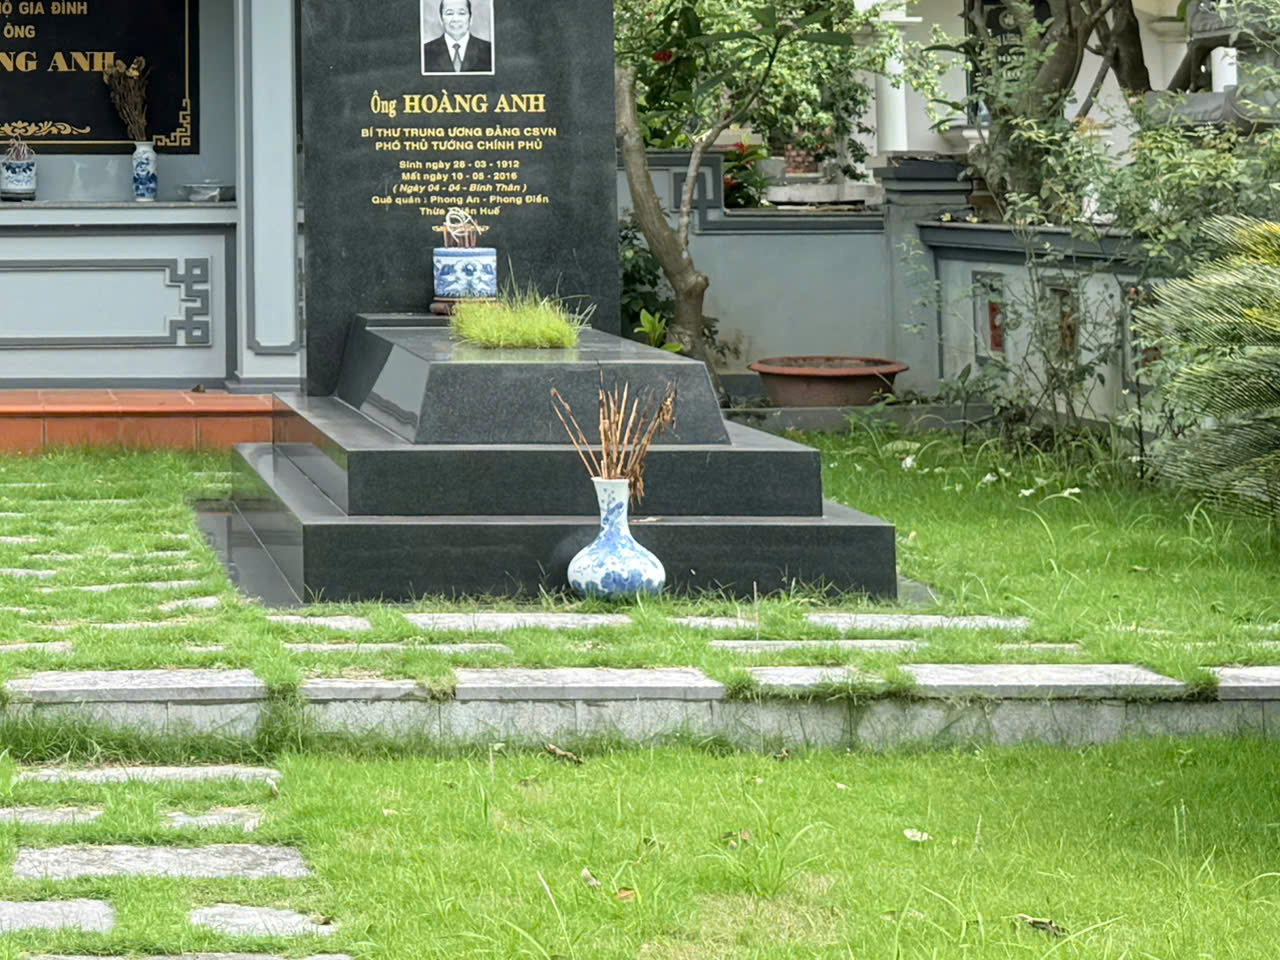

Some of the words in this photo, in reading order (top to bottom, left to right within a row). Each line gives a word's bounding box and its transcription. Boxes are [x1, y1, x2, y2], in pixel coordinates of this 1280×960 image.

[18, 1, 45, 15] GIA
[50, 0, 88, 15] ĐÌNH
[3, 22, 36, 38] ÔNG
[47, 51, 116, 73] ANH
[370, 89, 398, 118] Ông
[402, 88, 489, 114] HOÀNG
[493, 93, 547, 113] ANH
[361, 126, 374, 138] BÍ
[376, 127, 402, 138] THƯ
[404, 127, 446, 138] TRUNG
[485, 124, 521, 138] ĐẢNG
[523, 127, 557, 137] CSVN
[375, 139, 401, 151] PHÓ
[476, 138, 515, 151] CHÍNH
[517, 137, 543, 151] PHỦ
[399, 160, 423, 169] Sinh
[425, 160, 451, 171] ngày
[474, 160, 487, 169] 03
[496, 160, 520, 169] 1912
[423, 171, 449, 182] ngày
[451, 172, 464, 181] 10
[493, 172, 518, 181] 2016
[427, 184, 440, 193] 04
[372, 195, 393, 205] Quê
[429, 195, 464, 206] Phong
[488, 195, 522, 206] Phong
